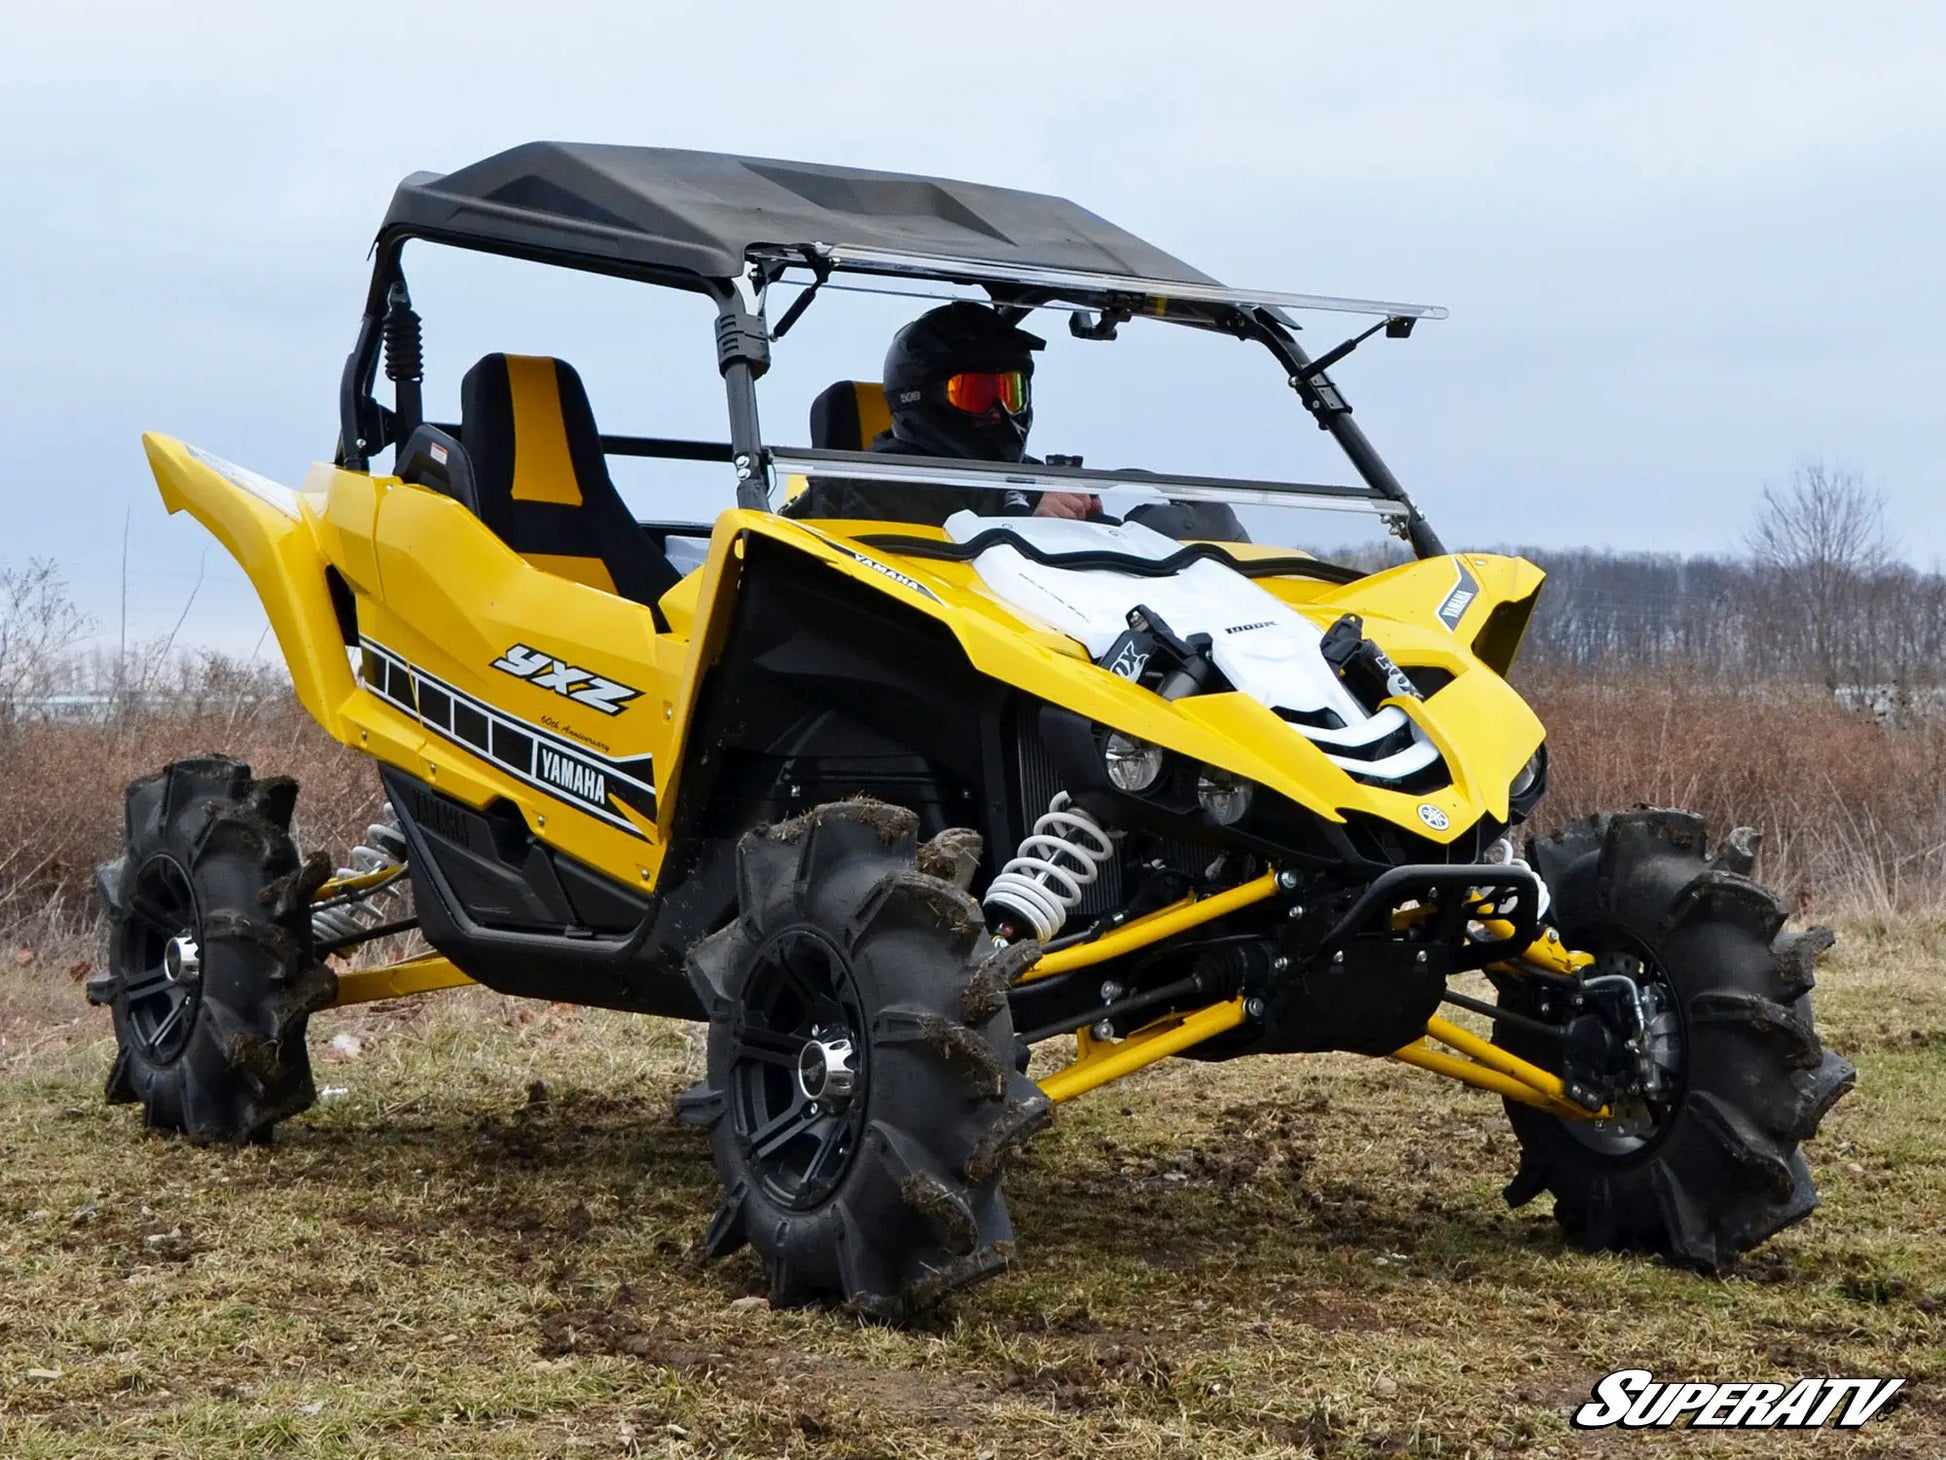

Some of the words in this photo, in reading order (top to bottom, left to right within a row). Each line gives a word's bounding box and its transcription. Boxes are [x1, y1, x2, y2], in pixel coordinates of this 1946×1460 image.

[854, 553, 919, 590] YAMAHA
[1441, 590, 1475, 618] YAMAHA
[1110, 640, 1149, 682] OX
[542, 748, 606, 805] YAMAHA
